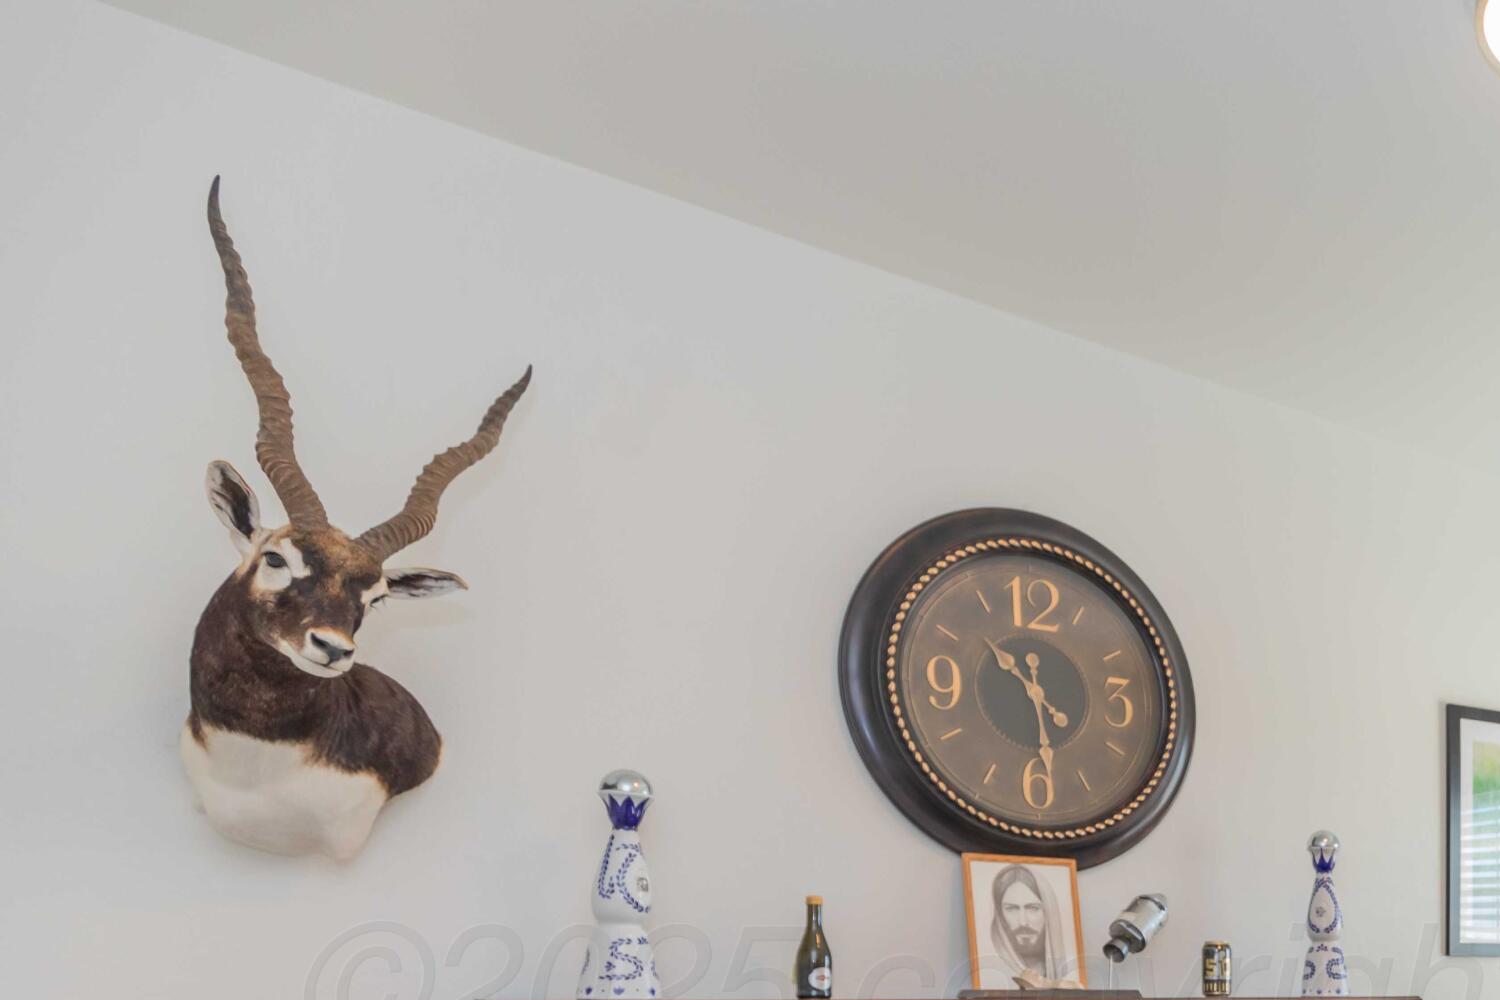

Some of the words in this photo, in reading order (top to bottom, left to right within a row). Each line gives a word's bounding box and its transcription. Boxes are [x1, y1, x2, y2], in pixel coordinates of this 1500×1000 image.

[1004, 575, 1061, 633] 12
[925, 655, 963, 710] 9
[1103, 676, 1134, 728] 3
[1021, 757, 1055, 810] 6
